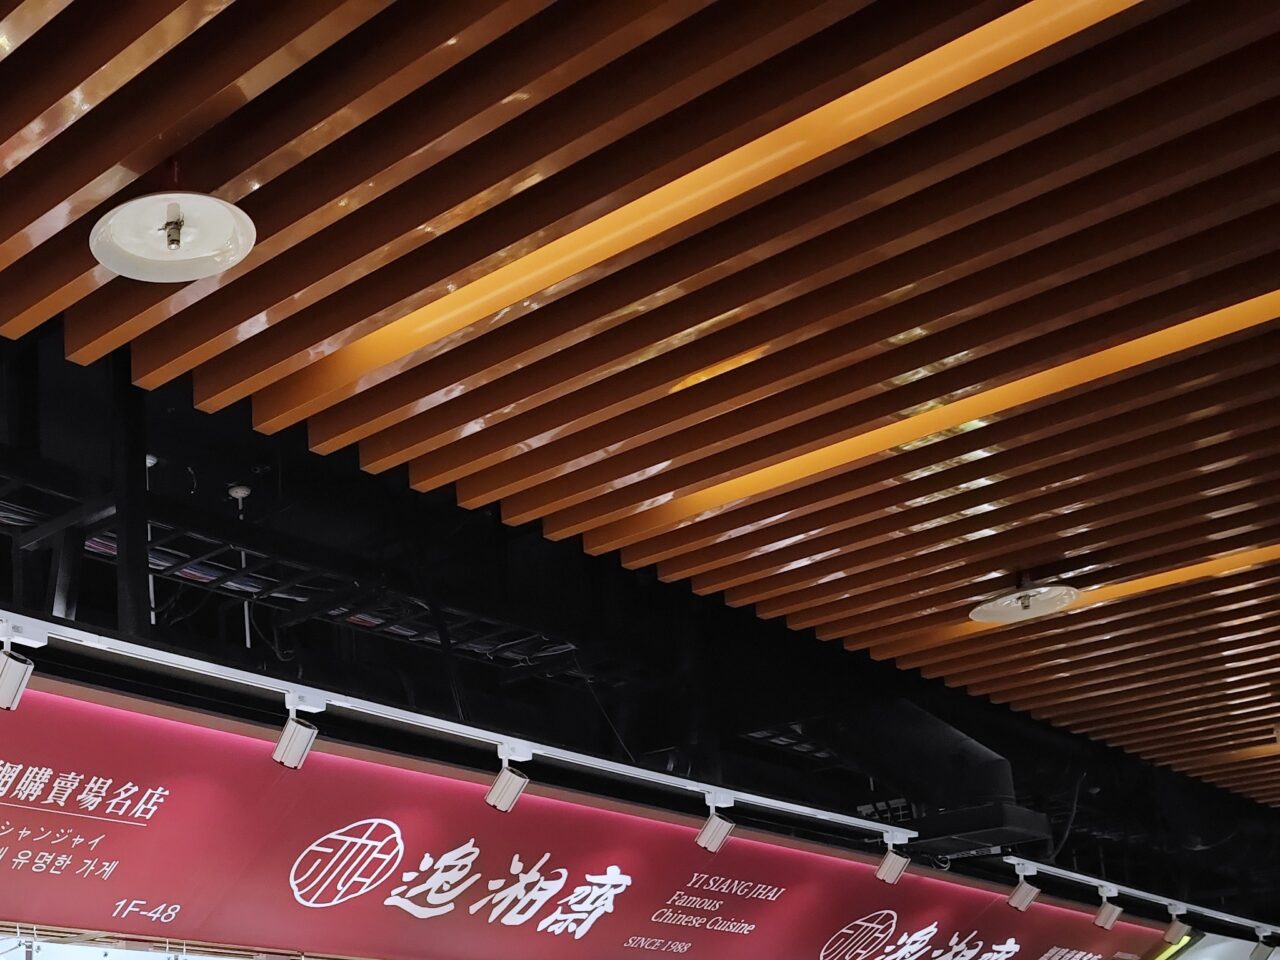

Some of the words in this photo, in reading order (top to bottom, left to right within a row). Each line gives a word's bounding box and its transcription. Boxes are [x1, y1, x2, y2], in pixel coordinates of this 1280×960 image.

[11, 850, 73, 874] 유명한
[76, 858, 119, 880] 가게
[383, 837, 631, 940] 逸湘齋
[686, 873, 709, 888] YI
[703, 875, 753, 896] SIANG
[746, 884, 786, 901] JHAI
[112, 899, 180, 922] 1F-48
[666, 891, 723, 911] Famous
[651, 908, 706, 927] Chinese
[706, 916, 756, 934] Cuisine
[624, 936, 664, 950] SINCE
[661, 941, 691, 953] 1988
